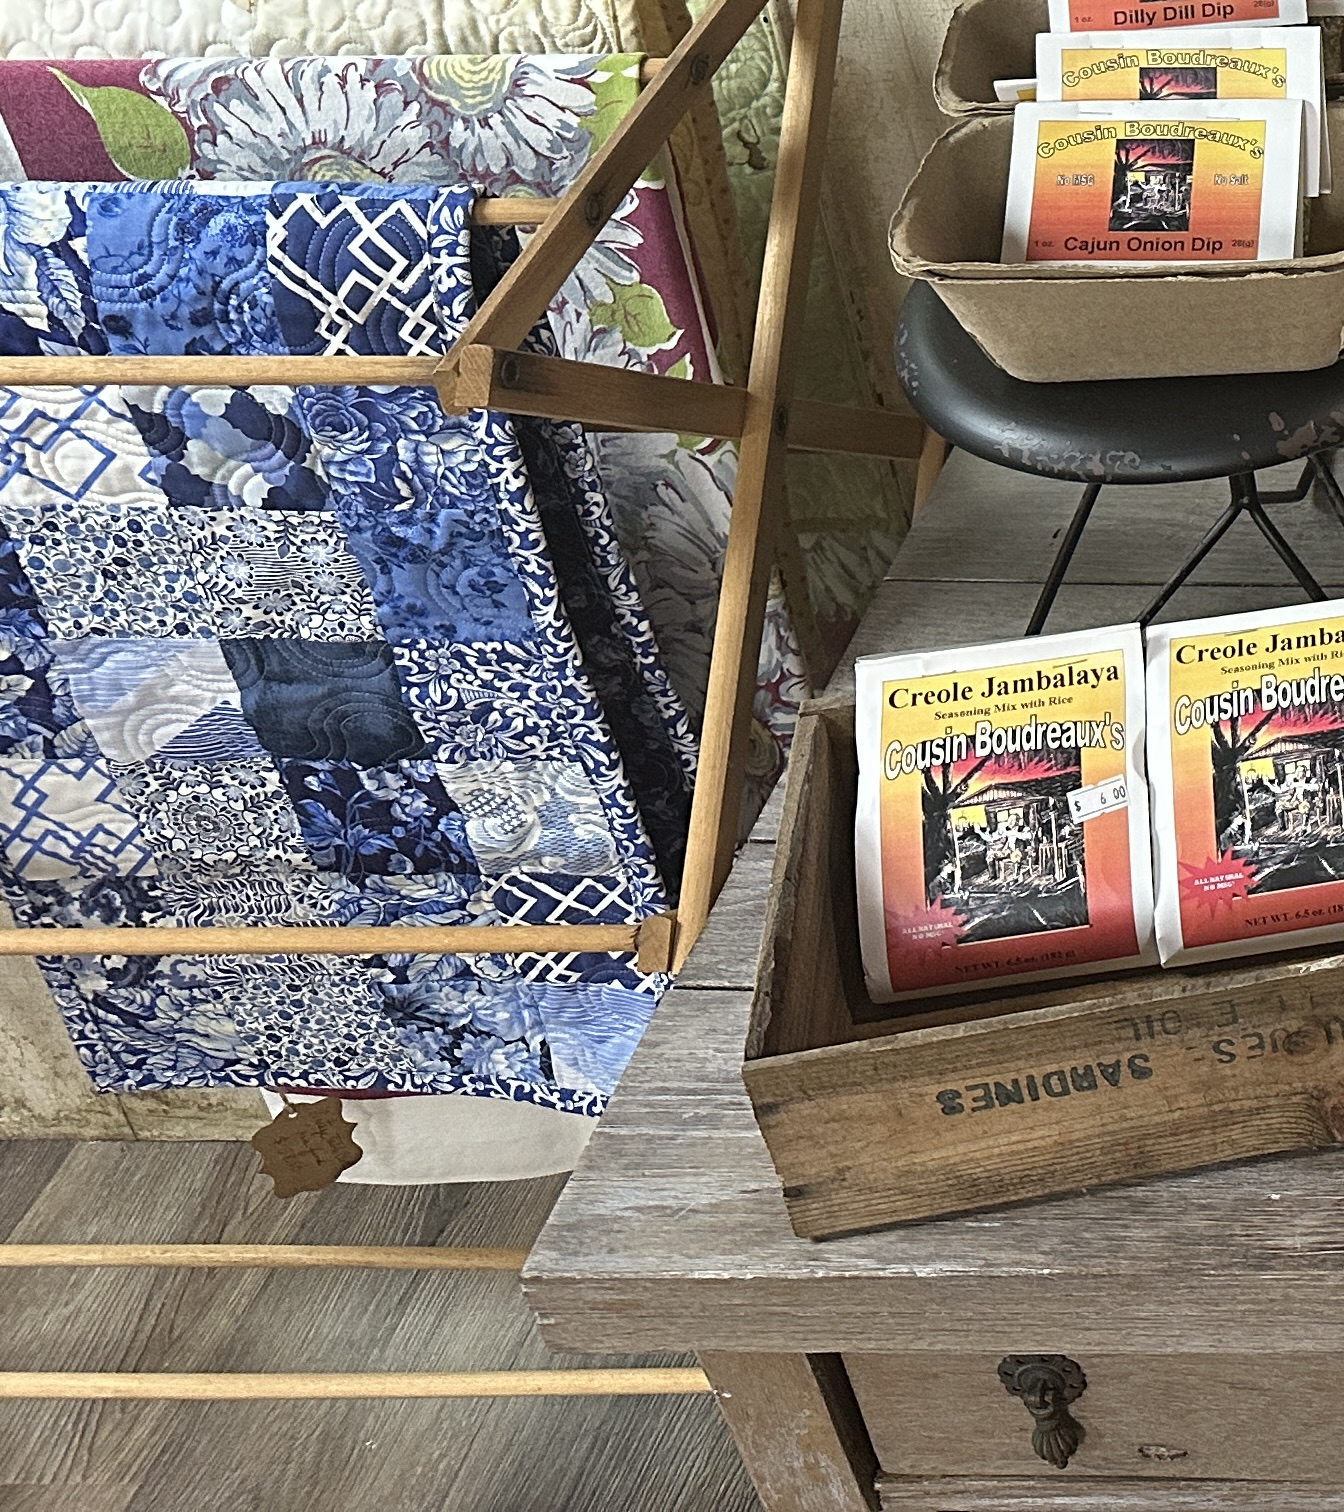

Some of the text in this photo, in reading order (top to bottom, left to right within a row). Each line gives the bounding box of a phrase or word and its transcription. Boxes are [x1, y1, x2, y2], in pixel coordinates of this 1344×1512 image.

[1113, 1, 1235, 27] Dilly Dill Dip
[1062, 49, 1287, 89] Cousin Boudreaux's
[1037, 120, 1265, 160] Cousin Boudreaux's
[1063, 236, 1224, 255] Cajun Onion Dip
[1175, 638, 1259, 666] Creole
[1220, 660, 1276, 676] Seasoning
[1278, 655, 1301, 669] Mix
[1304, 651, 1329, 664] with
[889, 663, 1120, 710] Creole Jambalaya
[934, 694, 1074, 721] Seasoning Mix with Rice
[1174, 680, 1254, 736] Cousin
[885, 712, 1125, 781] Cousin Boudreaux's
[1073, 784, 1127, 813] $ 00
[933, 1051, 1154, 1118] SARDINES
